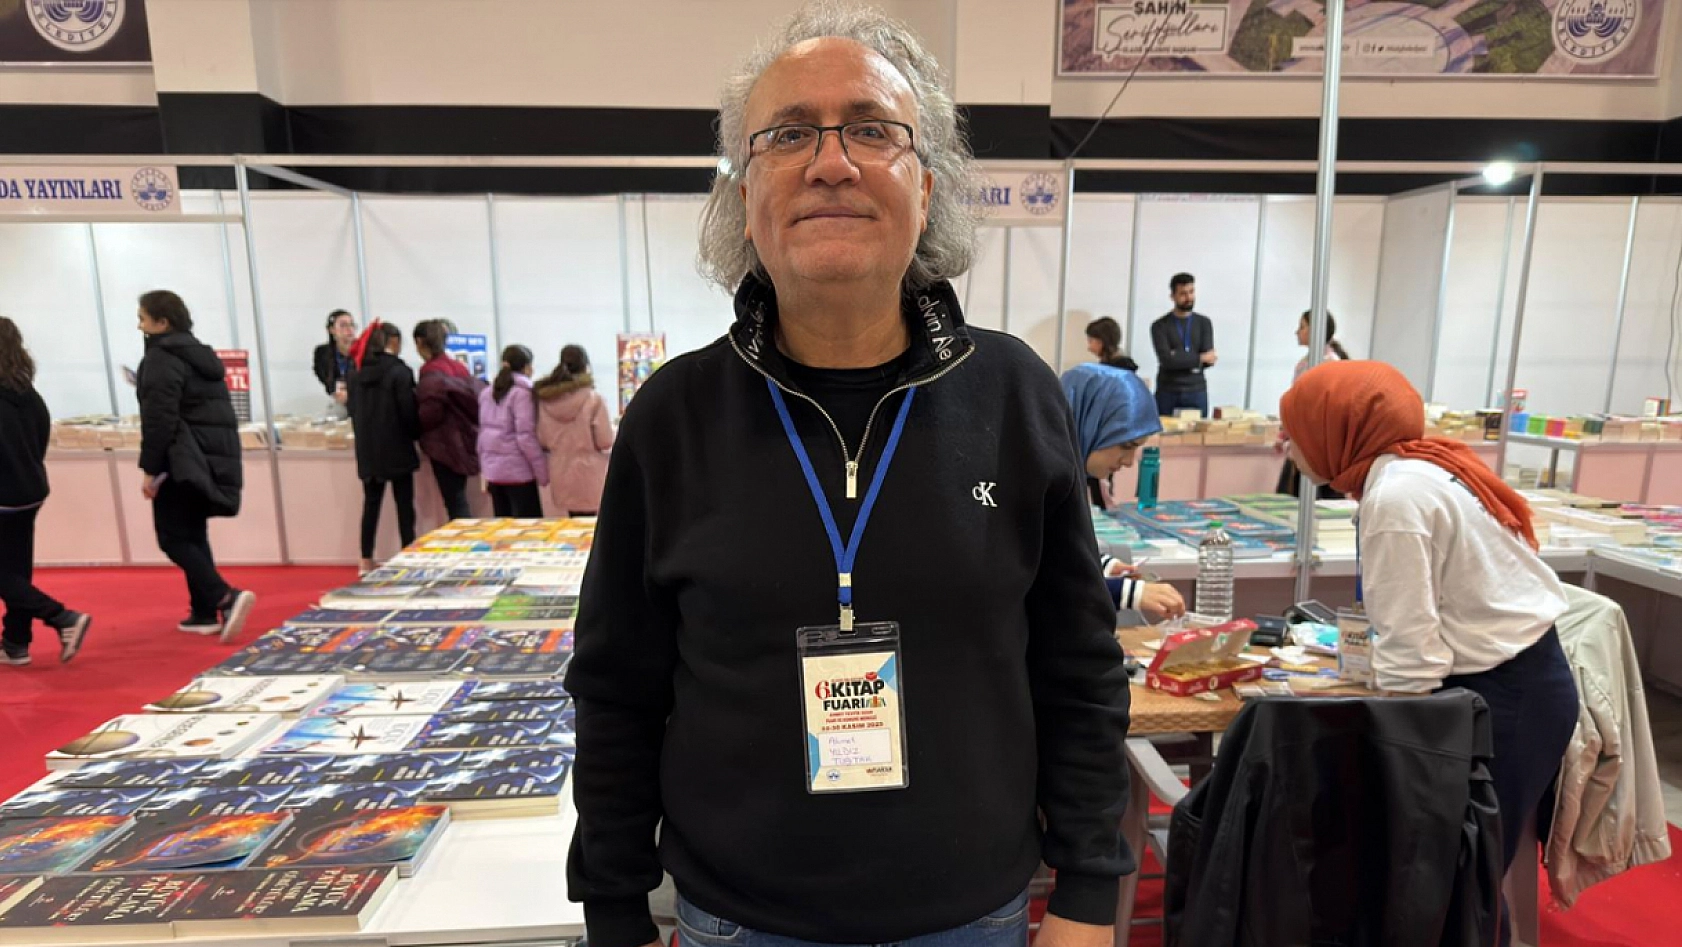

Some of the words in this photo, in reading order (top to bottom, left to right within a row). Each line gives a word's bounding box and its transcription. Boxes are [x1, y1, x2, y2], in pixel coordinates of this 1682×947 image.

[24, 178, 123, 200] YAYINLARI
[831, 678, 885, 698] KİTAP
[823, 697, 866, 712] FUARI
